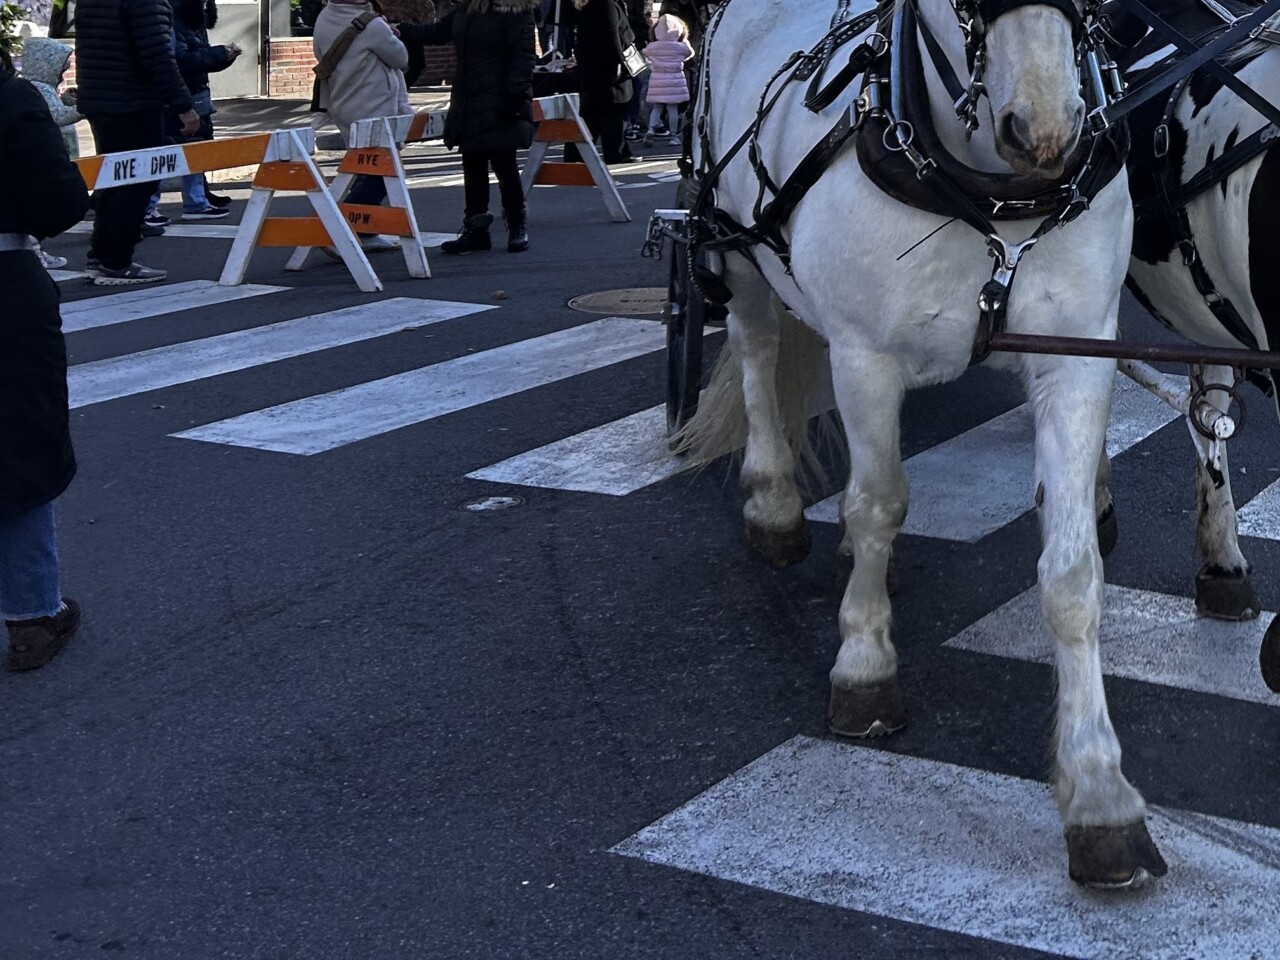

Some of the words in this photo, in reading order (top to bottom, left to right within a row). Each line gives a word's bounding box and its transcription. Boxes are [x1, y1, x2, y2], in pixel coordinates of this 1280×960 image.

[114, 158, 136, 180] RYE
[150, 153, 177, 175] DPW
[357, 154, 379, 166] RYE
[348, 212, 371, 225] DPW
